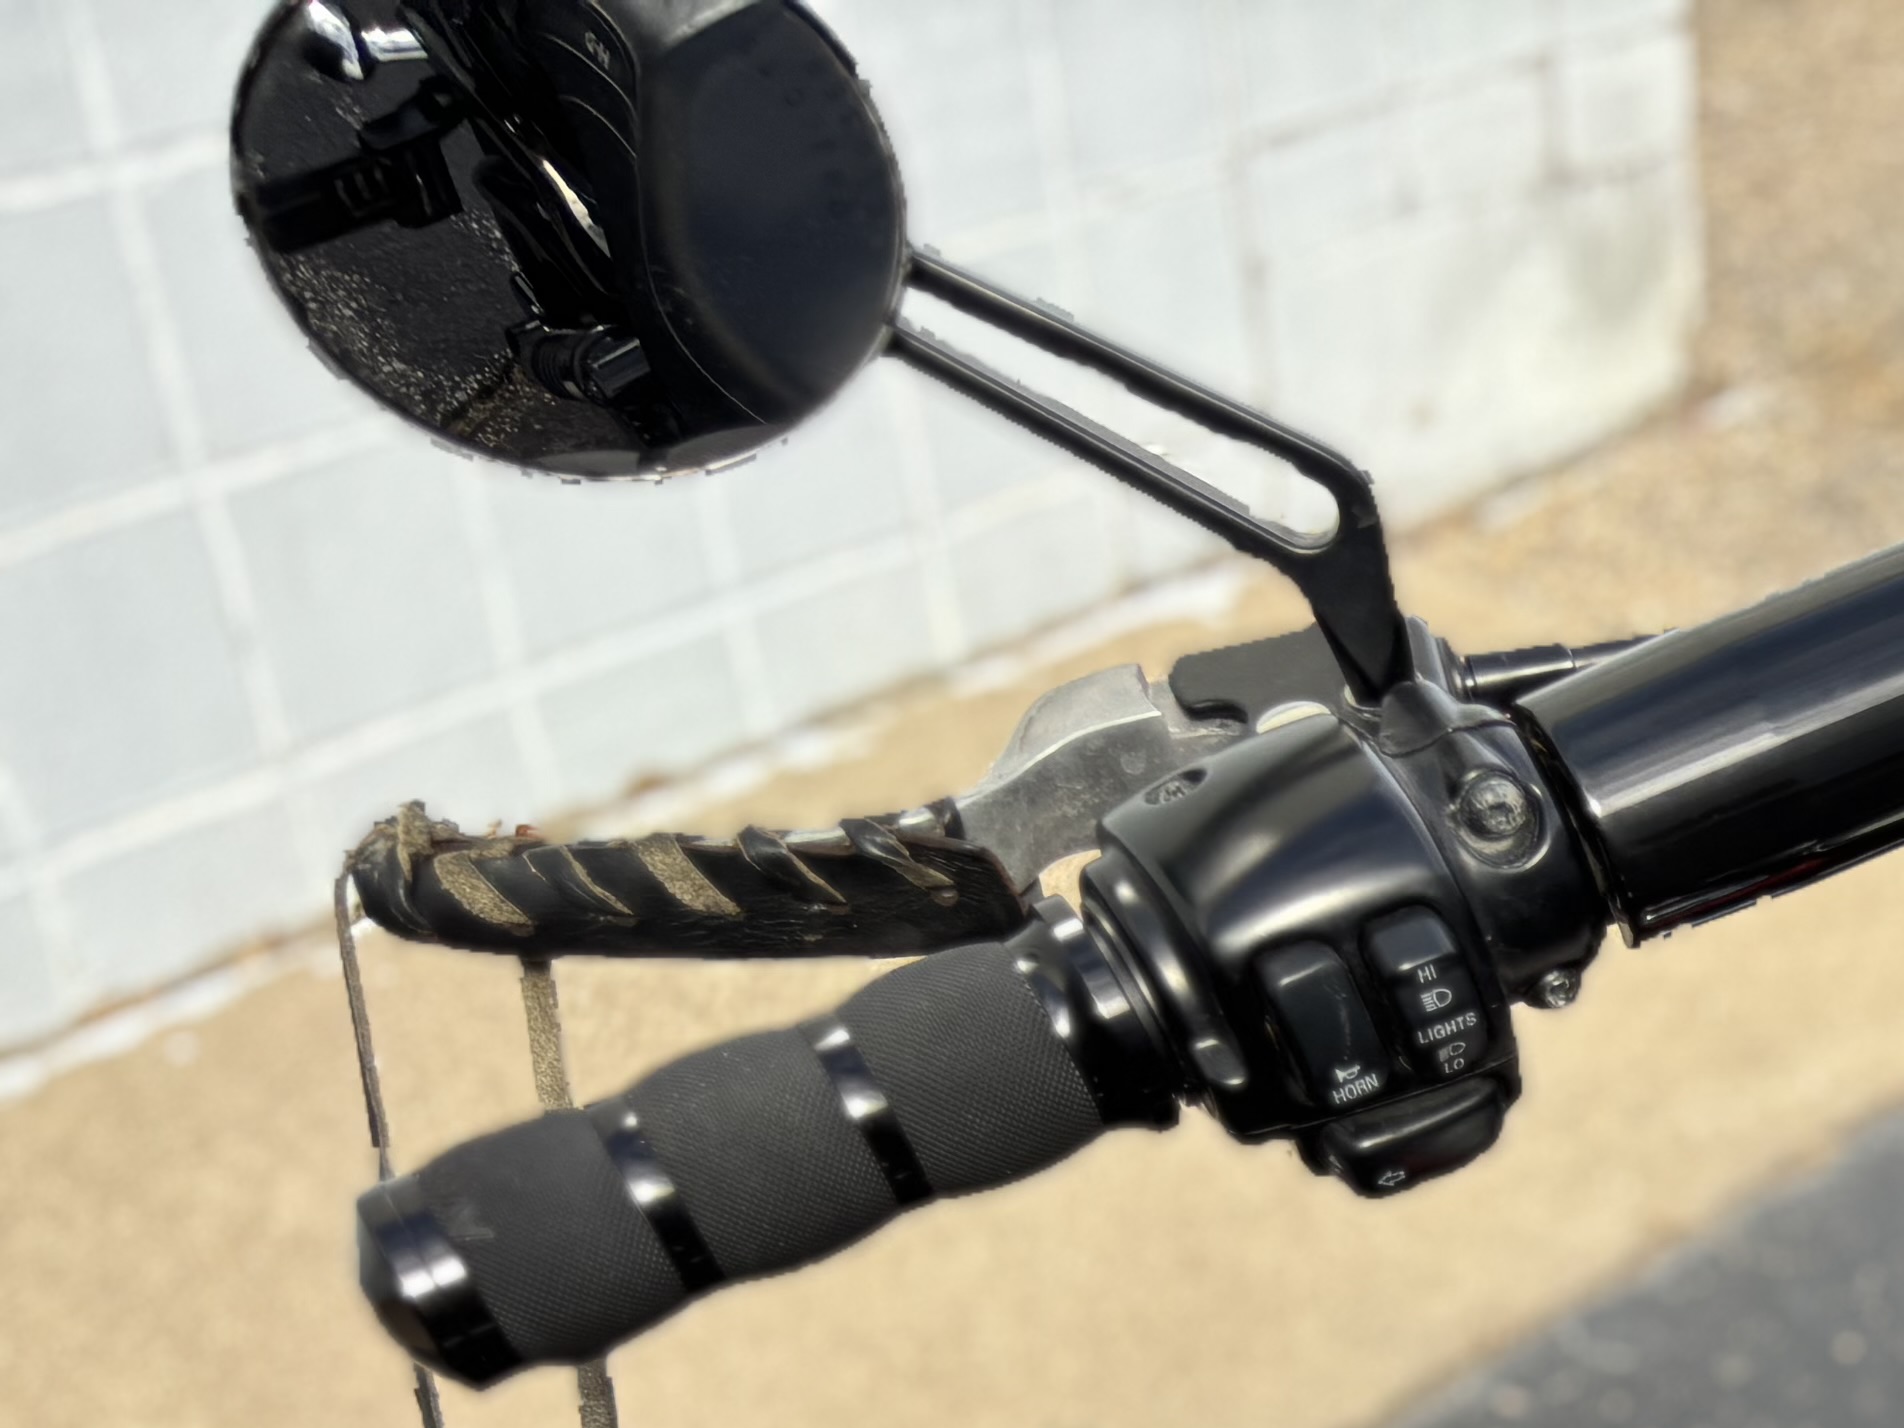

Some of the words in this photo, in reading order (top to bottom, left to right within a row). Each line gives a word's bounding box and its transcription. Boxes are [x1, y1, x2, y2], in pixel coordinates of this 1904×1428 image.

[1417, 964, 1438, 984] HI
[1417, 1012, 1477, 1045] LIGHTS
[1445, 1056, 1466, 1075] LO
[1332, 1073, 1380, 1105] HORN
